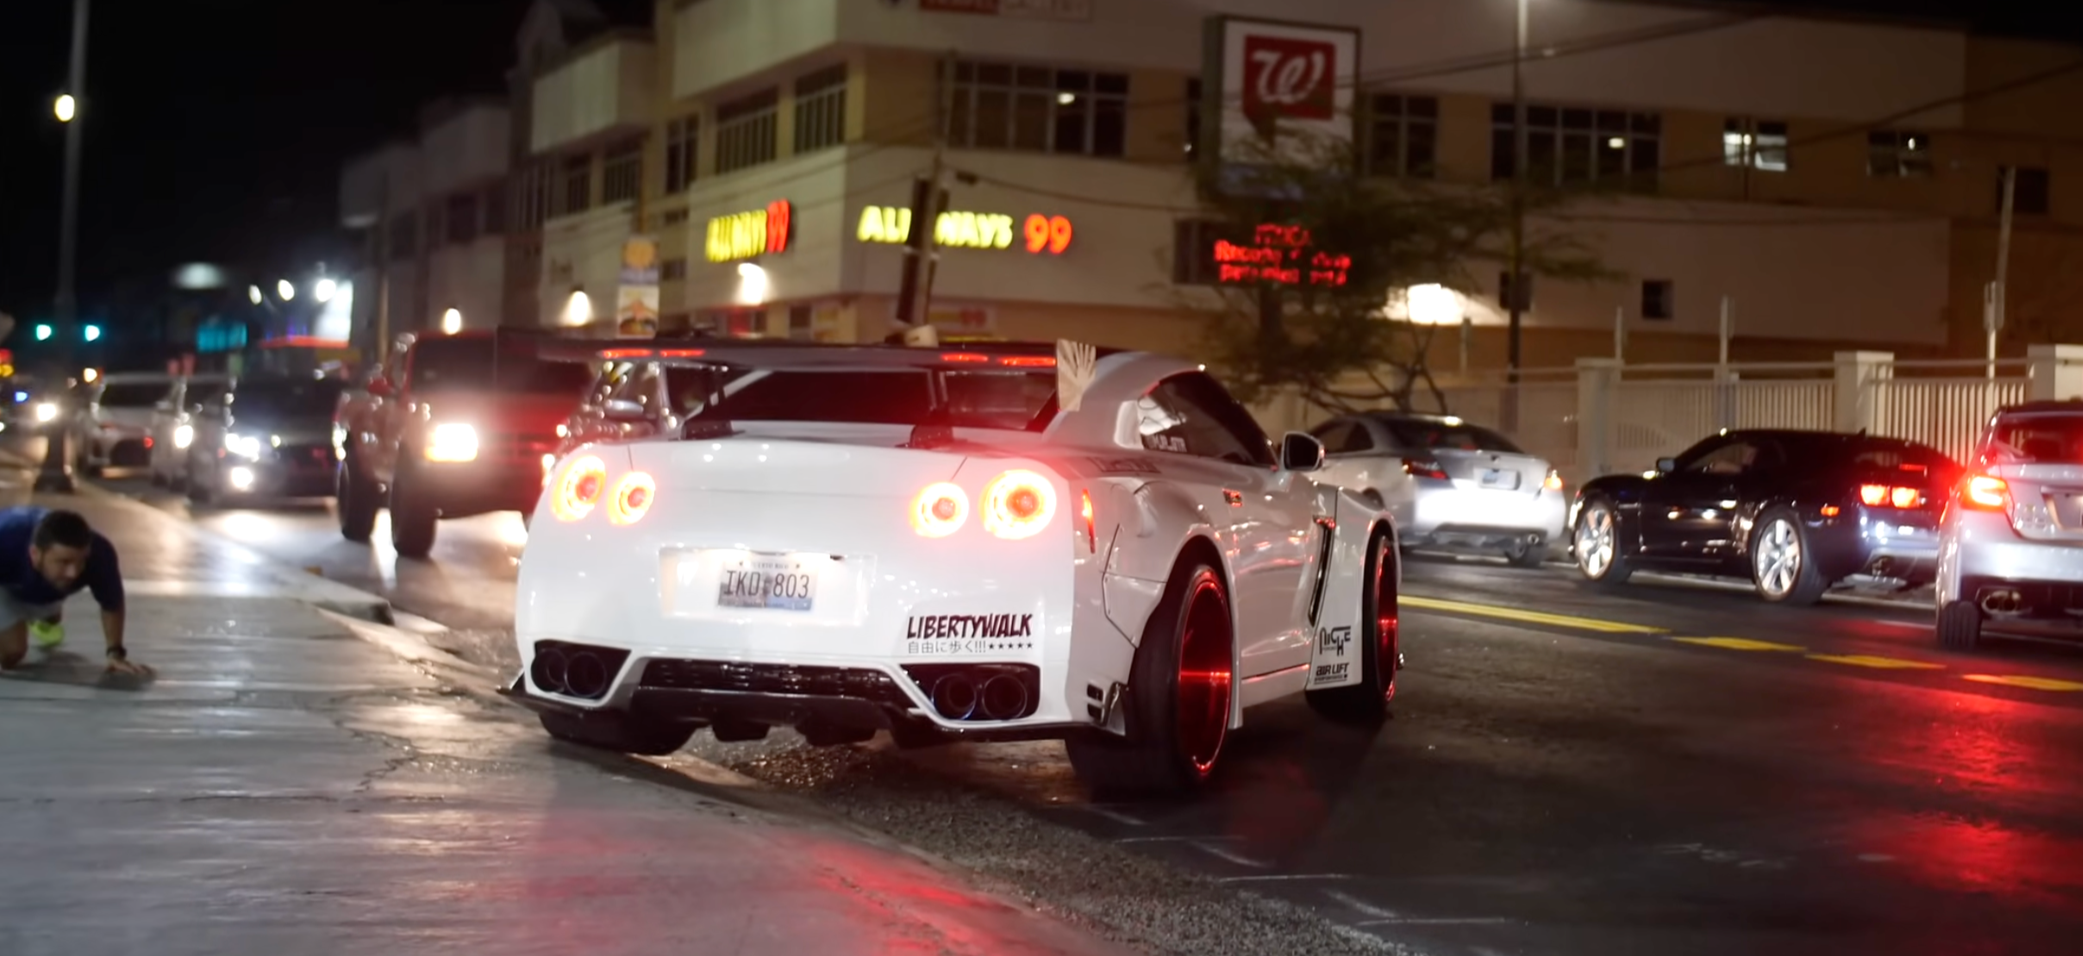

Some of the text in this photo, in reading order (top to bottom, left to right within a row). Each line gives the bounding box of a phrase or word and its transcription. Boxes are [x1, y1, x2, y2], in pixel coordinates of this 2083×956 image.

[767, 198, 790, 253] 99
[1024, 213, 1073, 254] 99
[773, 573, 810, 599] 803
[907, 613, 1033, 639] LIBERTYWALK
